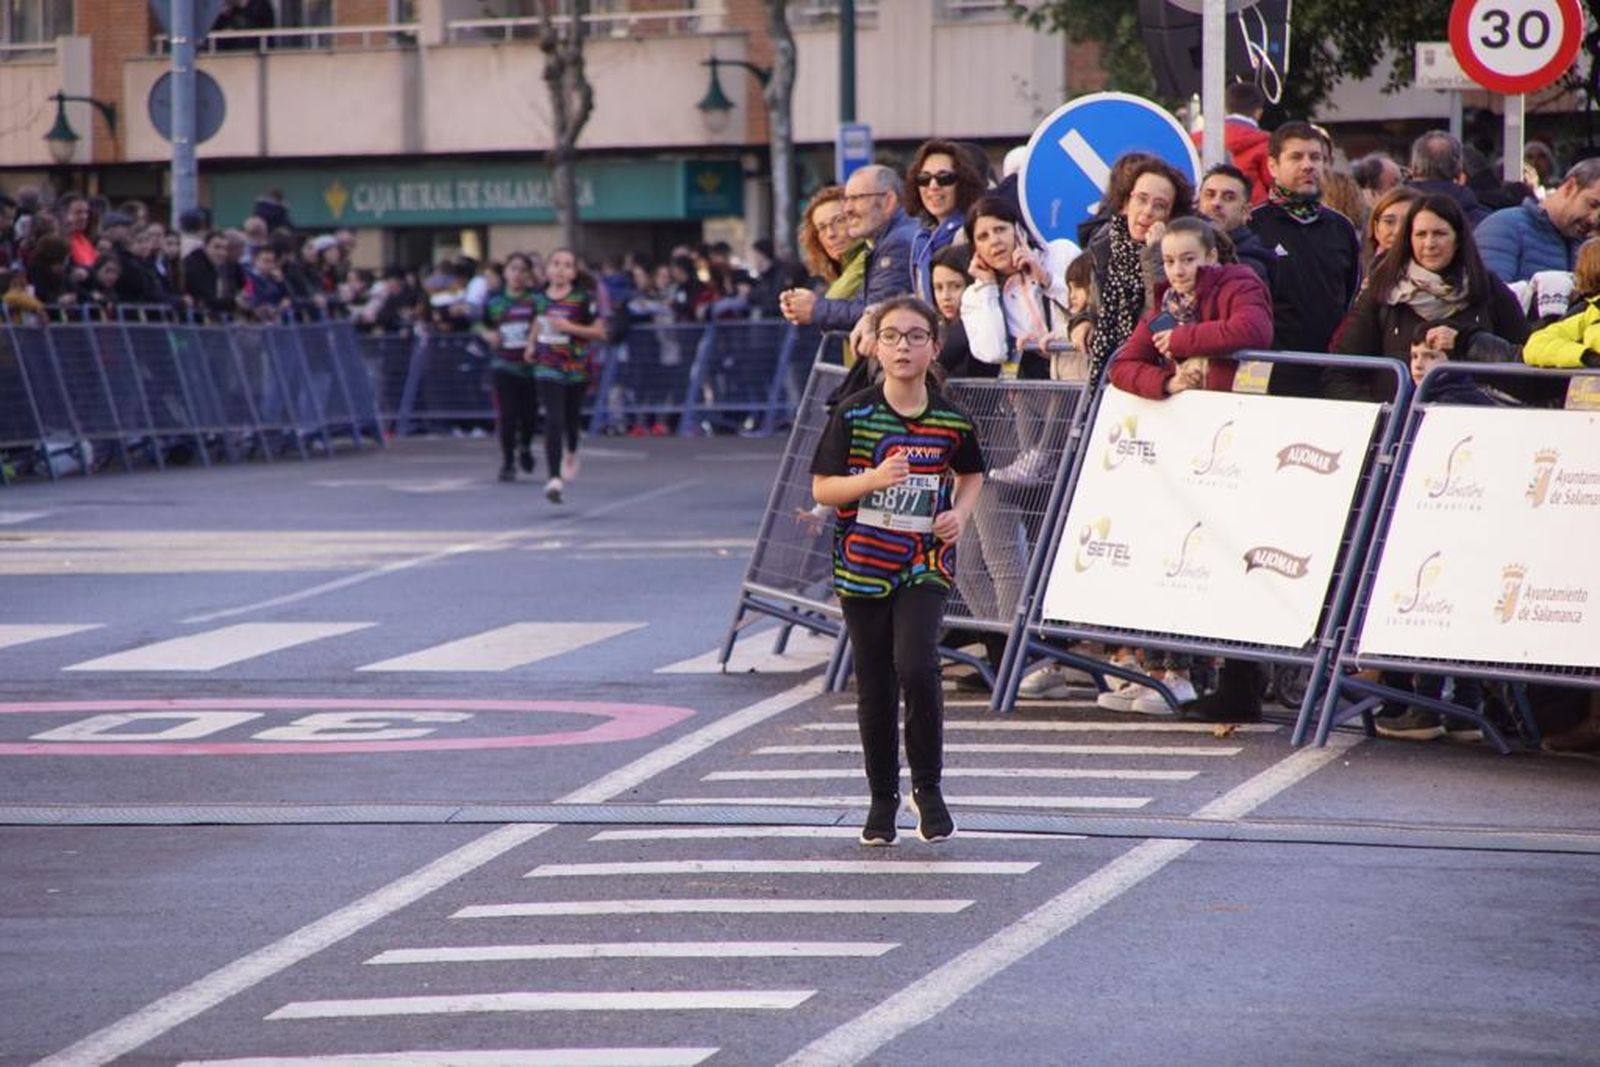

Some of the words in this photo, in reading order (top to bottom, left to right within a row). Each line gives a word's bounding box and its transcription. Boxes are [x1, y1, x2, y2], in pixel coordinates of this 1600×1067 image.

[1480, 9, 1550, 49] 30
[353, 183, 395, 219] CAJA
[456, 181, 479, 209] DE
[482, 178, 594, 209] SALAMCA
[1116, 439, 1157, 457] SETEL
[906, 476, 933, 488] TEL
[871, 486, 922, 511] 5877
[1086, 541, 1131, 560] SETEL
[1522, 584, 1588, 604] Ayuntamiento
[1518, 606, 1530, 621] de
[1531, 604, 1582, 623] Salamanca
[27, 711, 475, 741] 30
